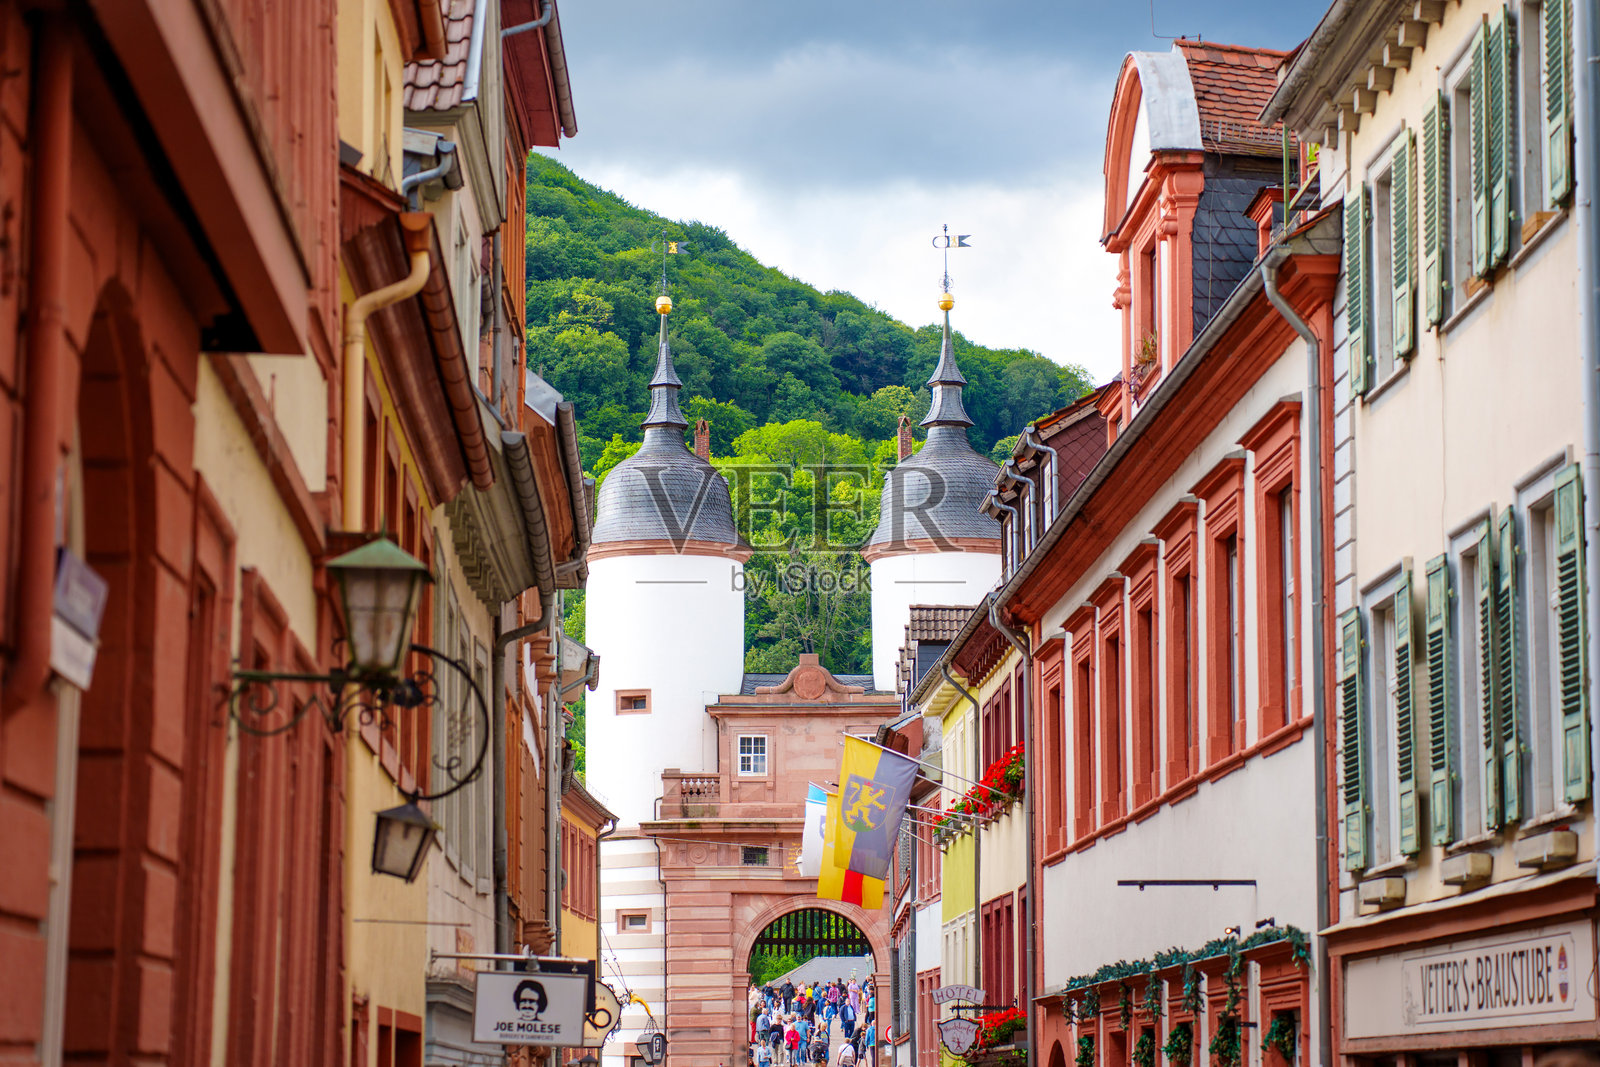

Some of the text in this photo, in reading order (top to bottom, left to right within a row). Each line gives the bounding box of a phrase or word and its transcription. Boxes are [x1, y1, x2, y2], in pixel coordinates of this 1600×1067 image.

[1420, 946, 1554, 1015] VETTER'S BRAUSTUBE
[935, 986, 982, 1003] HOTEL
[493, 1022, 561, 1034] JOE MOLESE
